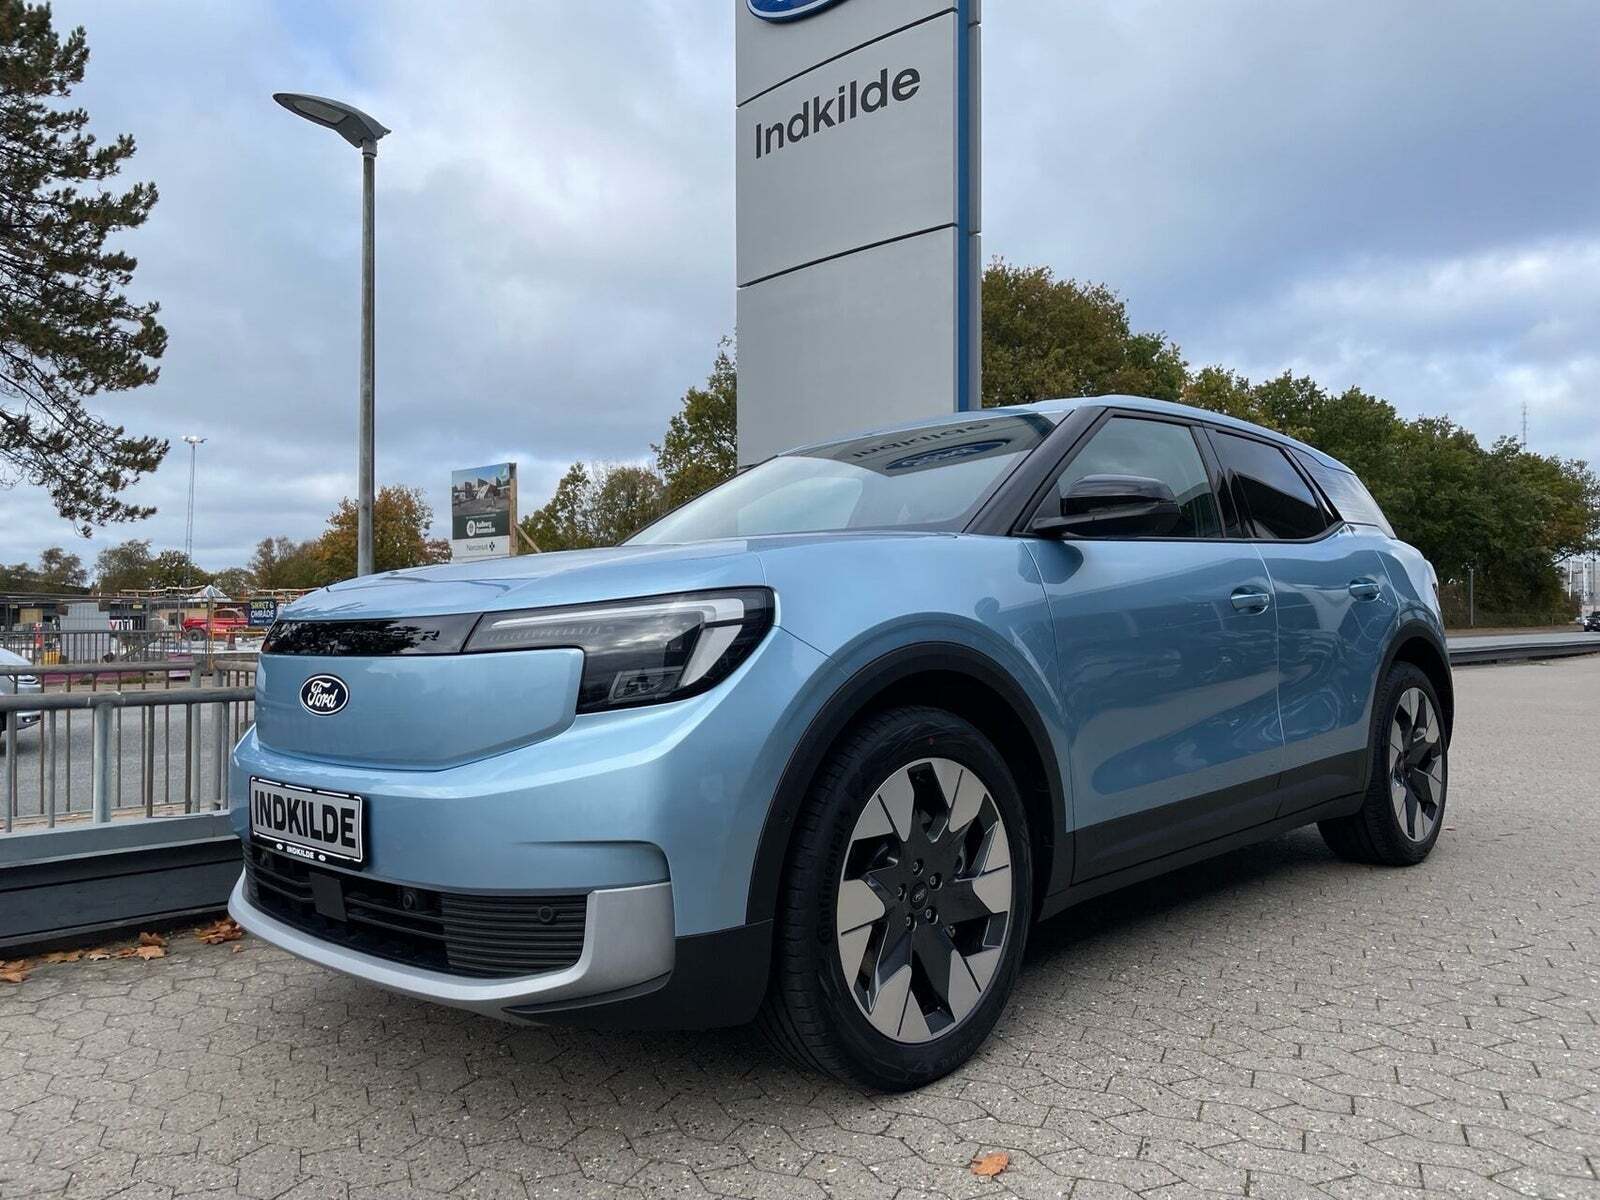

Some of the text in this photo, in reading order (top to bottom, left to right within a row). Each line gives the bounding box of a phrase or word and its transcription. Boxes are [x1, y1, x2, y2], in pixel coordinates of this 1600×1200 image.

[755, 67, 921, 159] Indkilde
[307, 680, 339, 709] Ford
[254, 789, 357, 849] INDKILDE
[286, 845, 315, 860] INDKILDE
